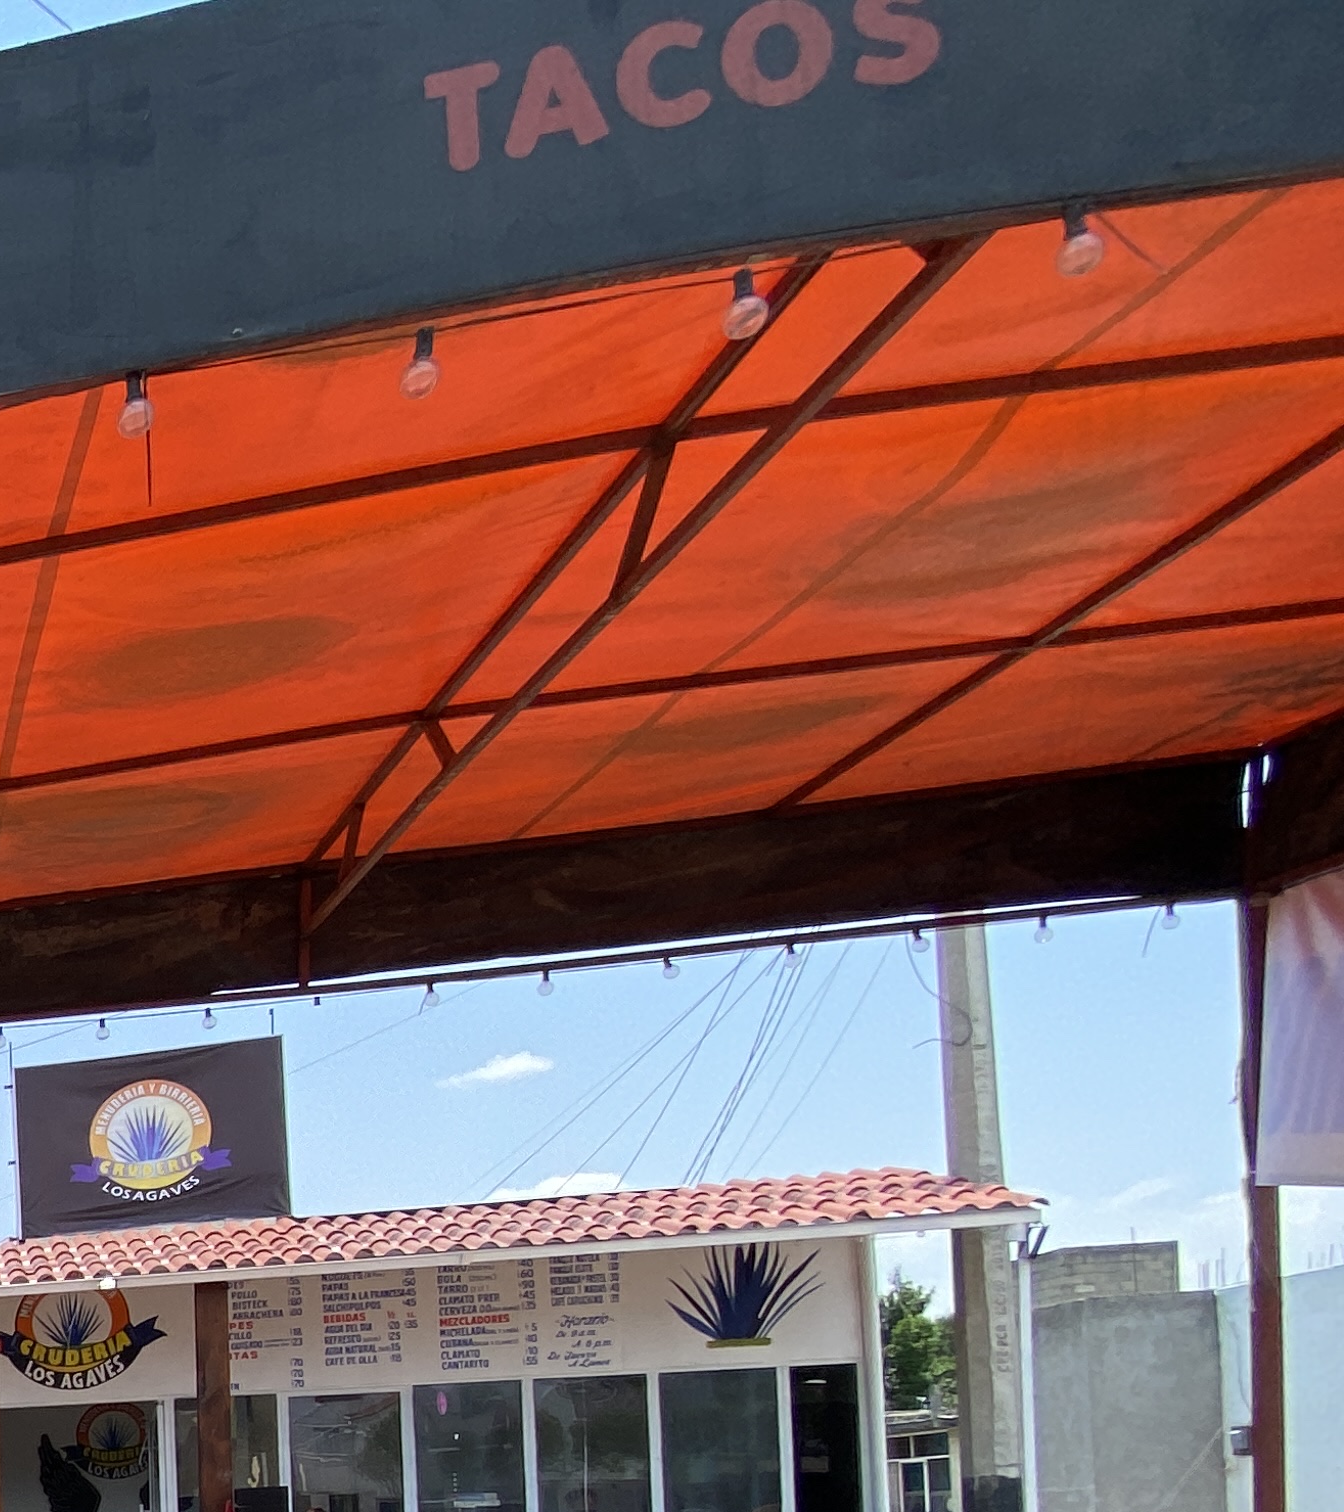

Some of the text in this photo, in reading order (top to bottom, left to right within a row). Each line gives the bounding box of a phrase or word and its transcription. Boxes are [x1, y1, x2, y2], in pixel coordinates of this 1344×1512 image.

[424, 0, 941, 172] TACOS
[96, 1083, 207, 1136] MENUDERIA Y BIRRIERIA
[99, 1151, 204, 1178] CRUDERIA
[437, 1275, 461, 1284] BOLA
[322, 1283, 349, 1292] PAPAS
[438, 1285, 468, 1294] TARRO
[231, 1290, 257, 1299] POLLO
[323, 1293, 349, 1303] PAPAS
[359, 1291, 369, 1300] LA
[439, 1295, 474, 1305] CLAMATO
[232, 1300, 268, 1310] BISTECK
[439, 1305, 477, 1316] CERVEZA
[323, 1313, 366, 1324] BEBIDAS
[440, 1314, 510, 1327] MEZCLADORES
[230, 1321, 254, 1330] PES
[20, 1330, 132, 1367] CRUDERIA
[230, 1351, 258, 1360] TAS
[441, 1349, 480, 1360] CLAMATO
[25, 1354, 125, 1389] LOS AGAVES
